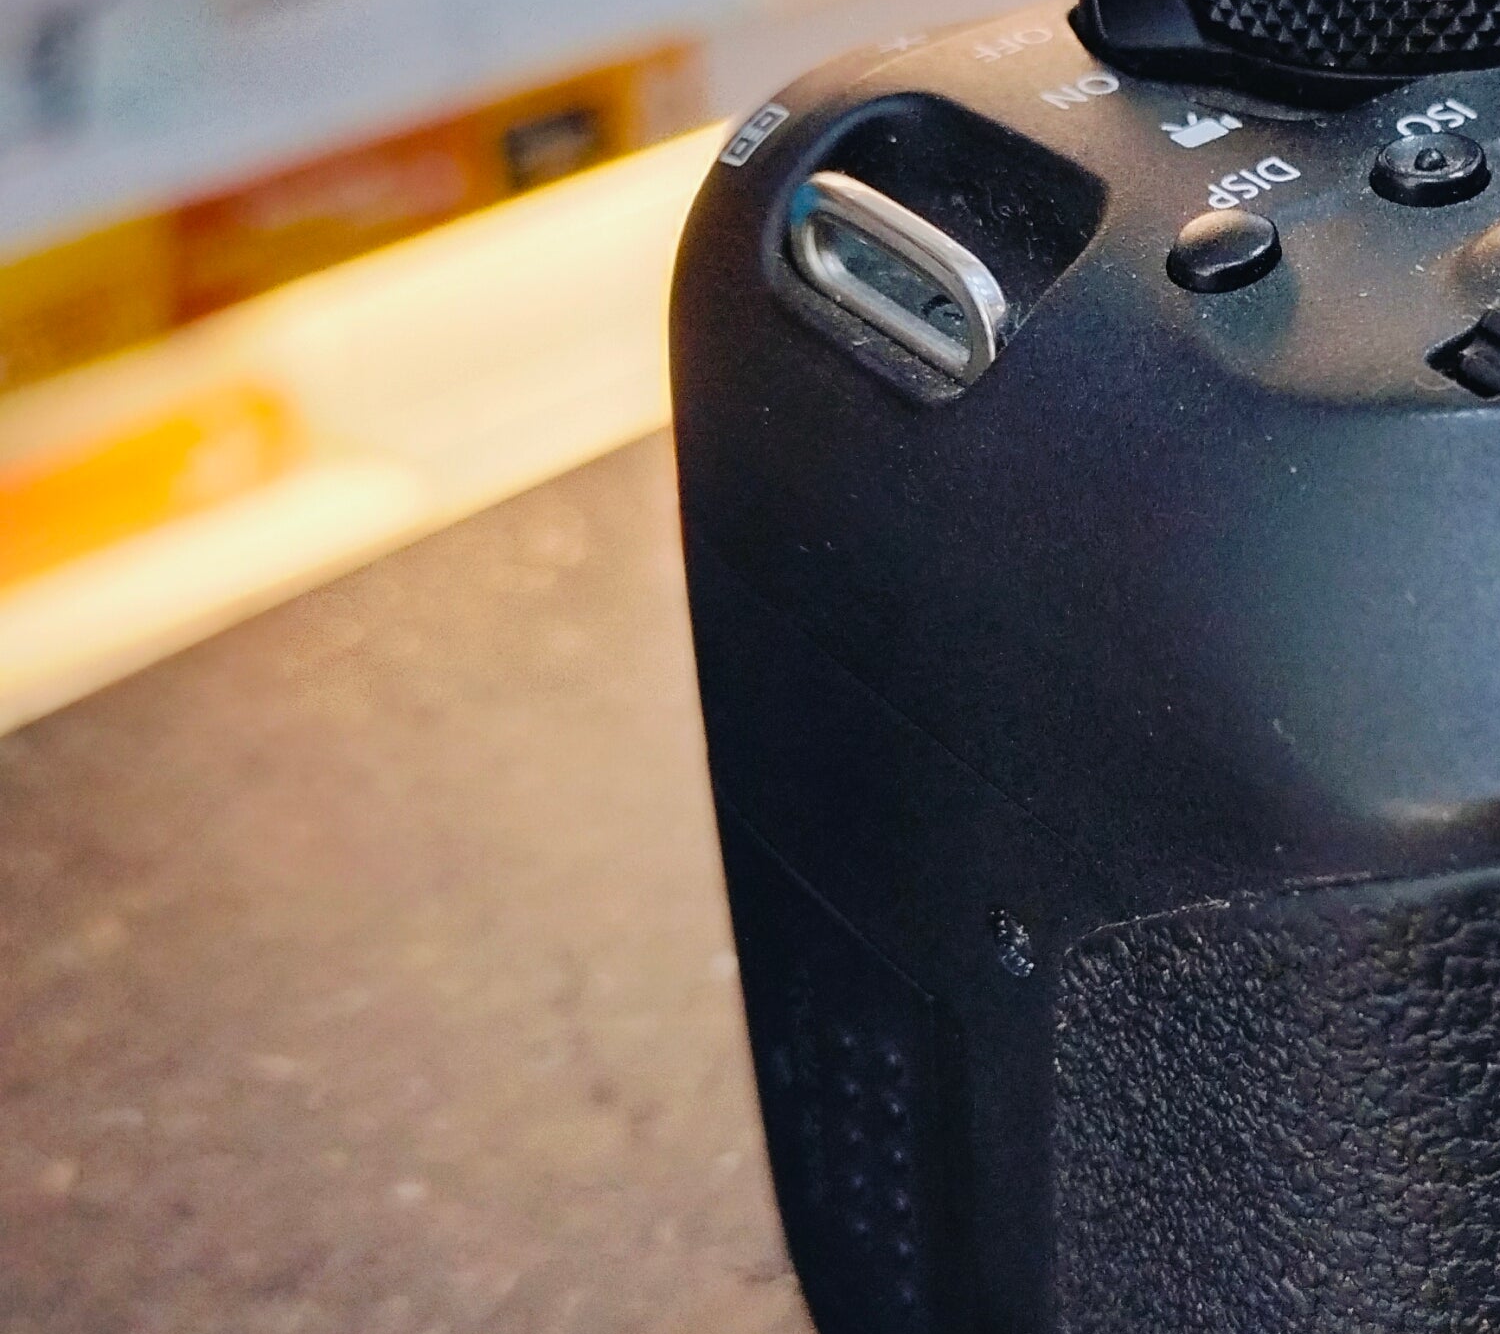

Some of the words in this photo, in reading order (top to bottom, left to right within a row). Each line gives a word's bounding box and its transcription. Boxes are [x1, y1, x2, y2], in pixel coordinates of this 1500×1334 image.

[974, 28, 1054, 64] OFF
[1041, 71, 1120, 111] ON
[1396, 98, 1478, 136] ISO
[1207, 156, 1301, 210] DISP
